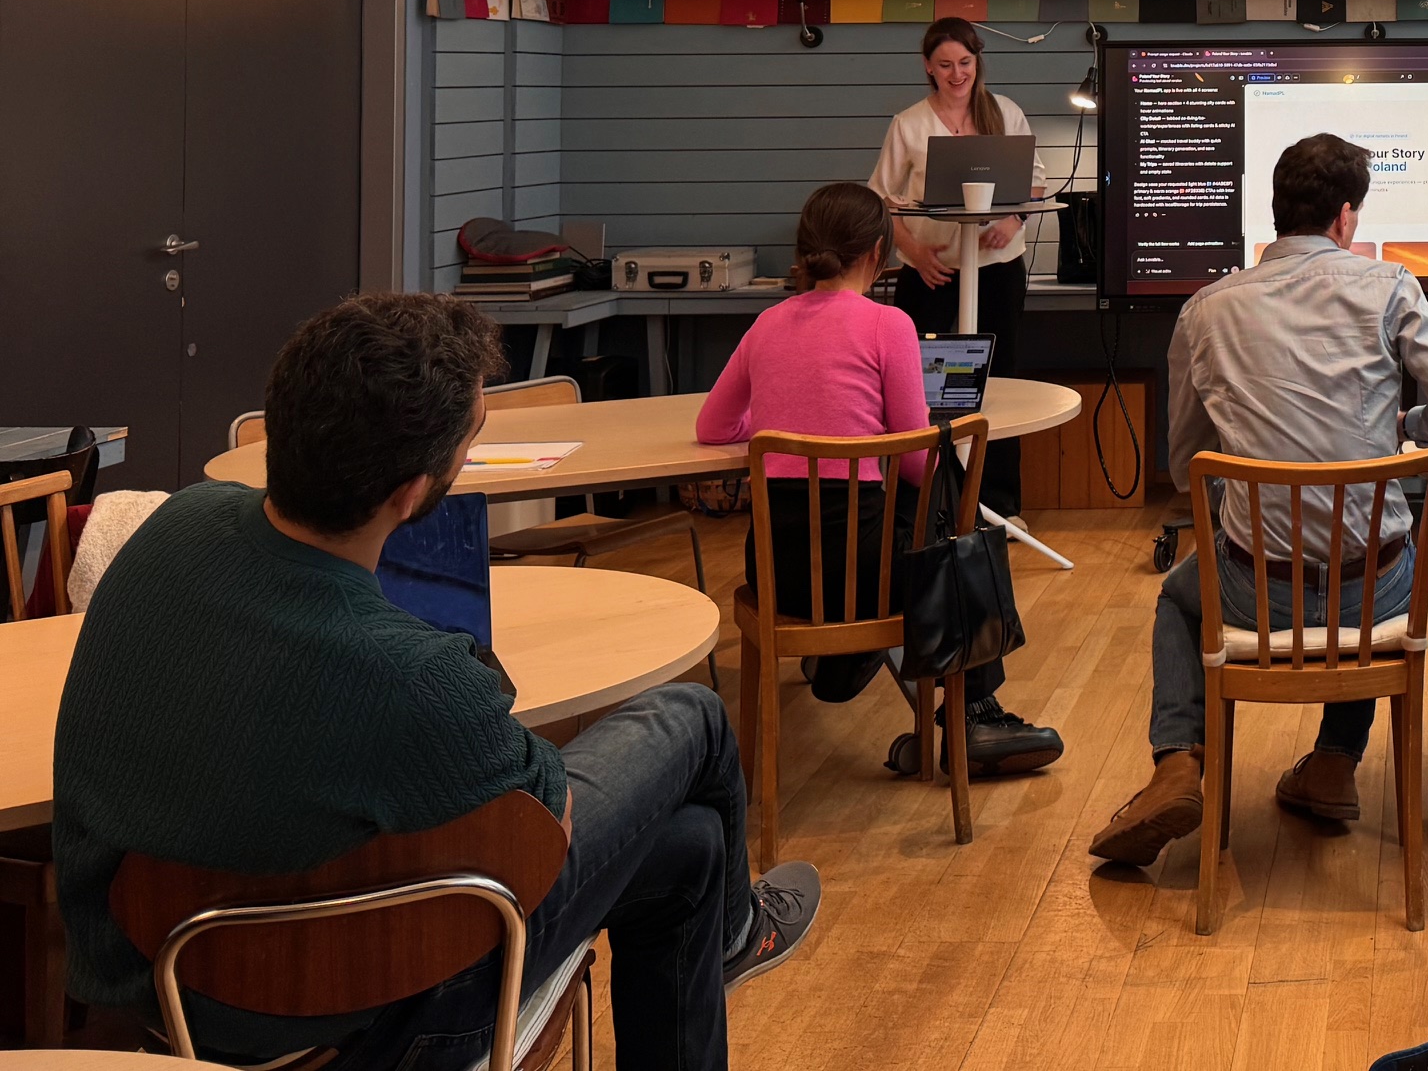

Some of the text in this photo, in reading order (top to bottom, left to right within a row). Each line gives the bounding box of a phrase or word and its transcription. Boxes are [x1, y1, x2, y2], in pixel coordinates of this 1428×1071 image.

[1370, 148, 1424, 160] our Story
[1373, 161, 1406, 171] oland
